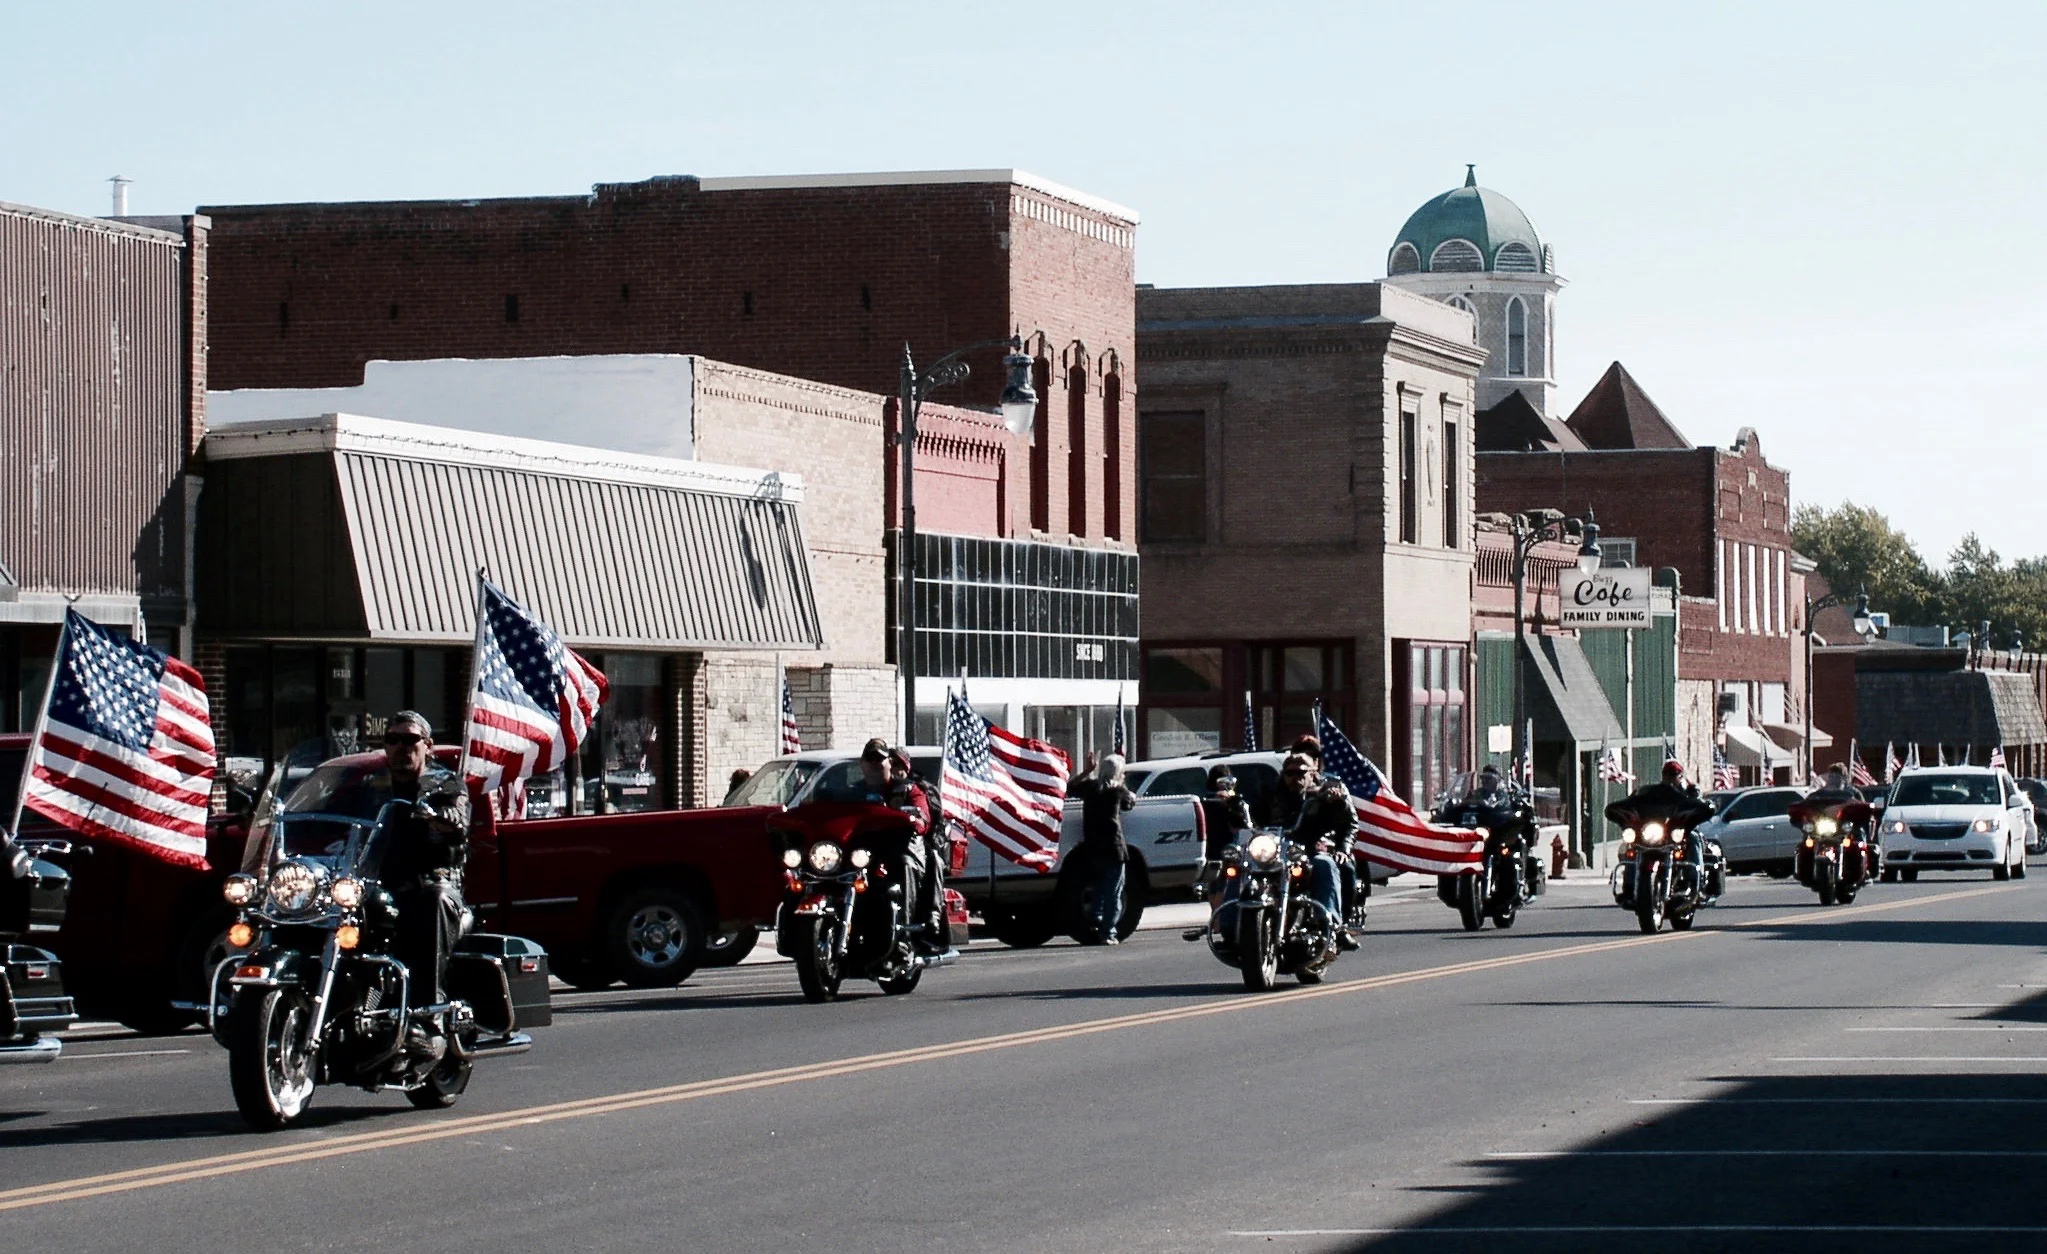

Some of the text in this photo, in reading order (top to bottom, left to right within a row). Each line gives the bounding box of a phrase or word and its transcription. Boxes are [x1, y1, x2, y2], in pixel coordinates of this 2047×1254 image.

[1563, 611, 1645, 622] FAMILY DINING
[1154, 829, 1193, 845] Z71
